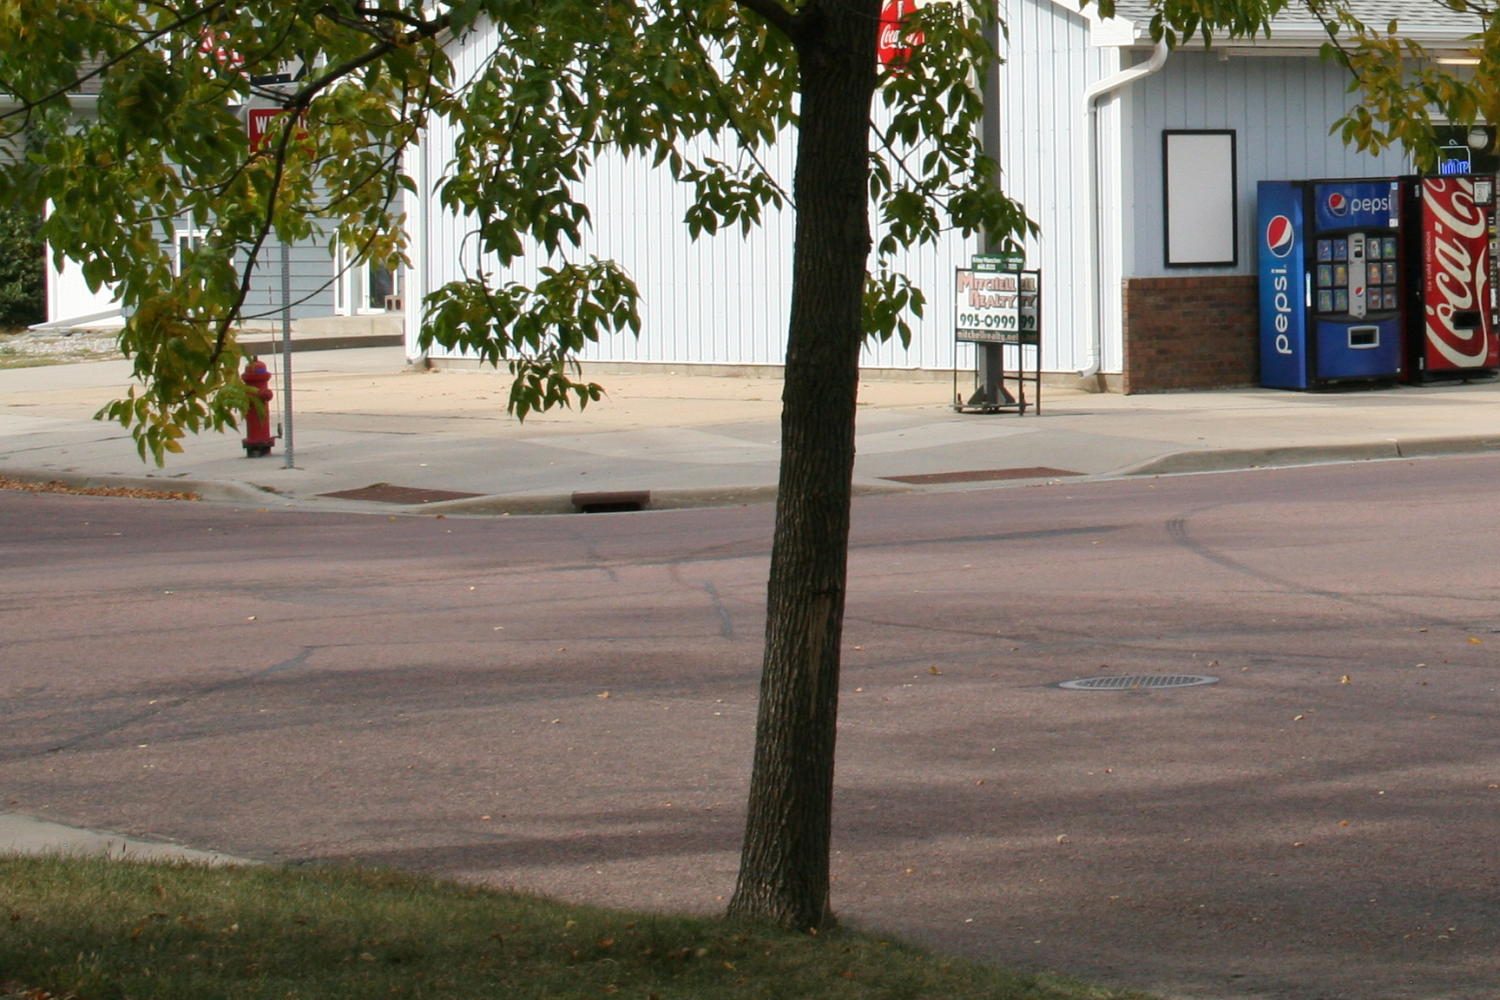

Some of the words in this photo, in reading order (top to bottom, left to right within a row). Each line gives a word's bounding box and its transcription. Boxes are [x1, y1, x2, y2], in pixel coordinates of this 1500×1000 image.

[1351, 195, 1391, 215] pepsi
[960, 313, 1016, 328] 995-0999
[1271, 267, 1292, 354] pepsi
